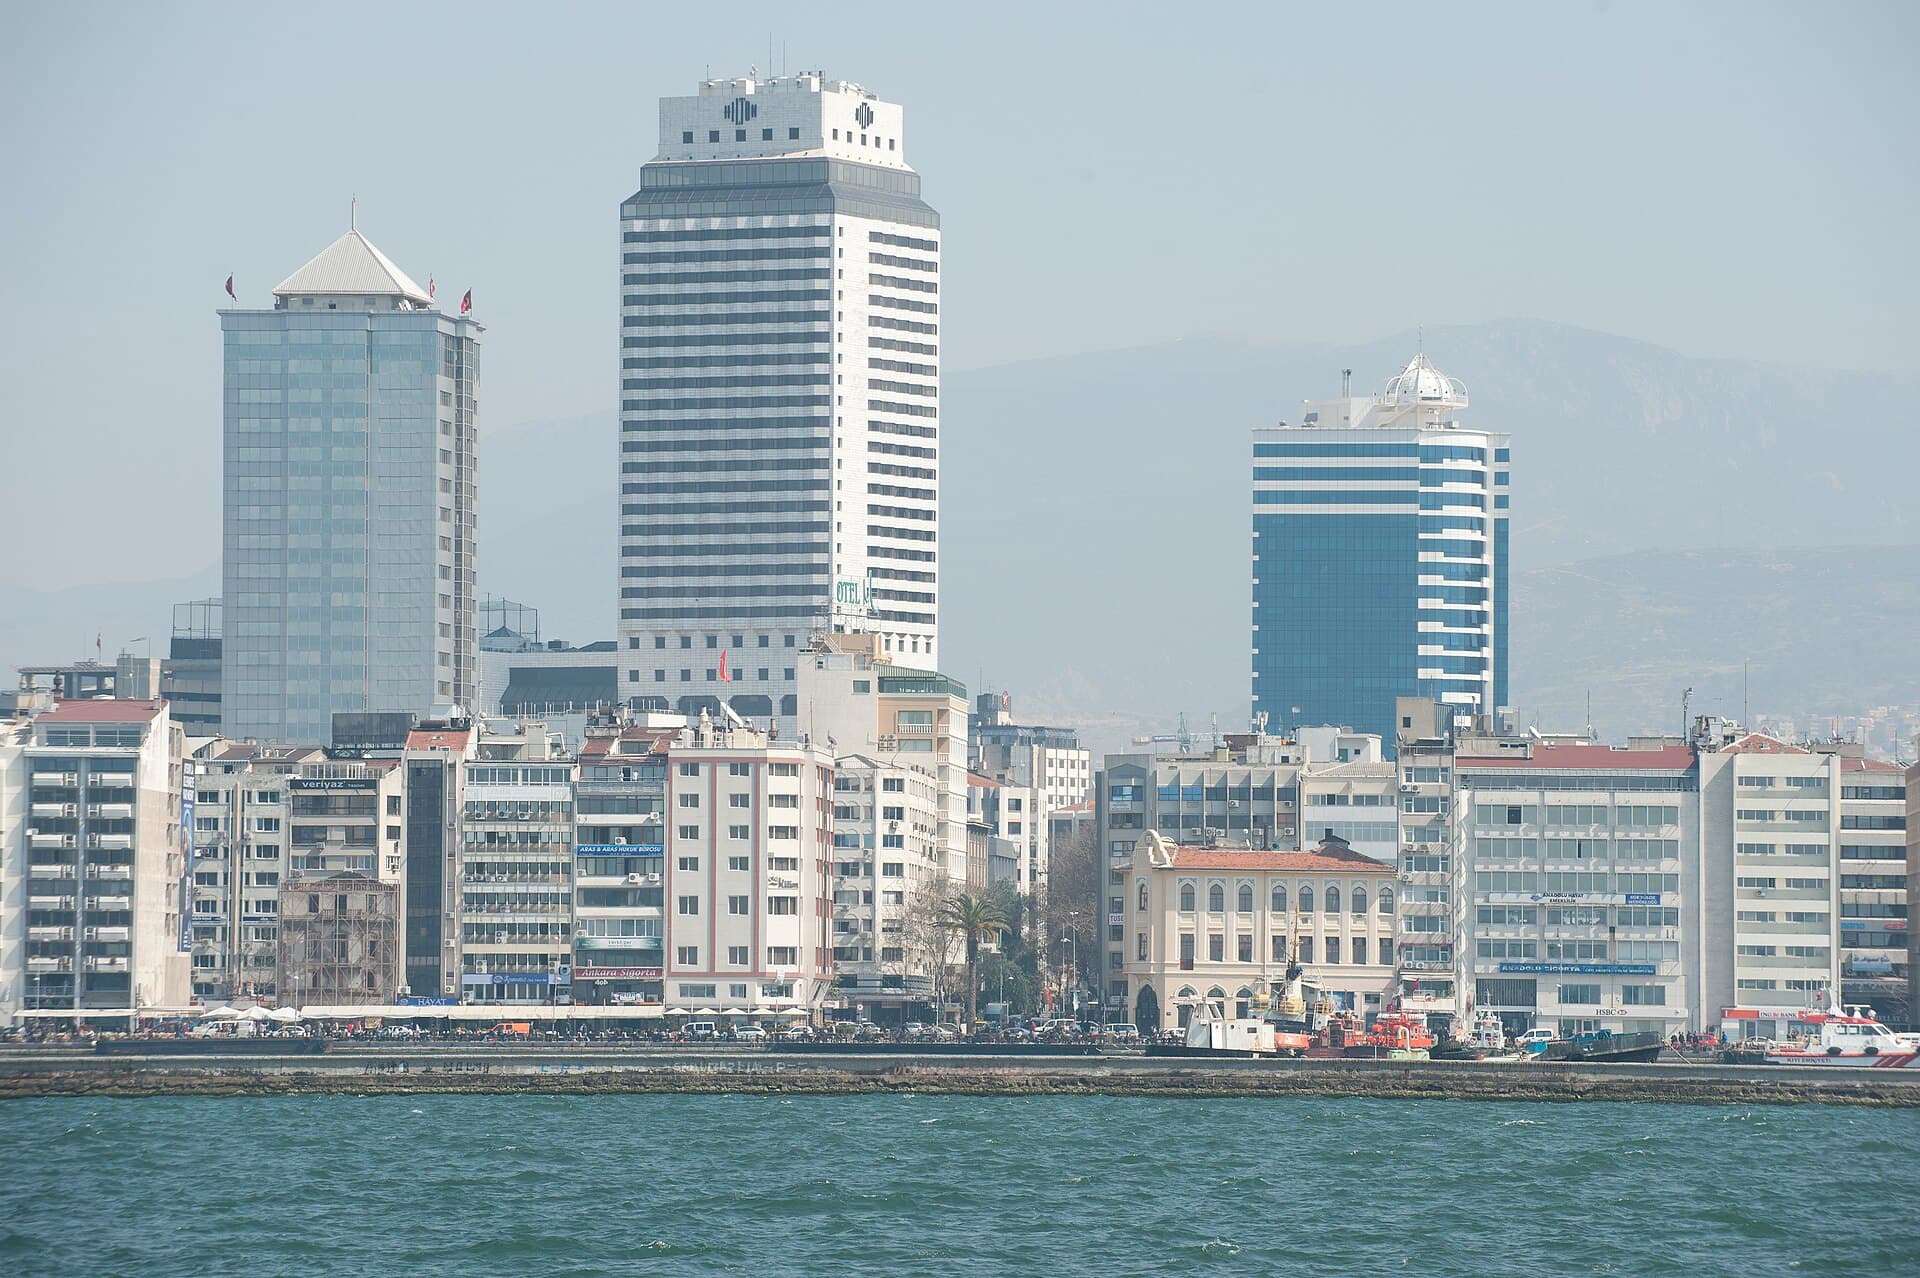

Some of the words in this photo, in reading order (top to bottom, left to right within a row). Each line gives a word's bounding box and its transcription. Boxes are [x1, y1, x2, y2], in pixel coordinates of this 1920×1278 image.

[724, 97, 757, 126] HILTON
[836, 581, 860, 605] OTEL
[581, 968, 617, 977] Ankara
[620, 968, 656, 978] Sigorta
[417, 998, 447, 1006] HAYAT
